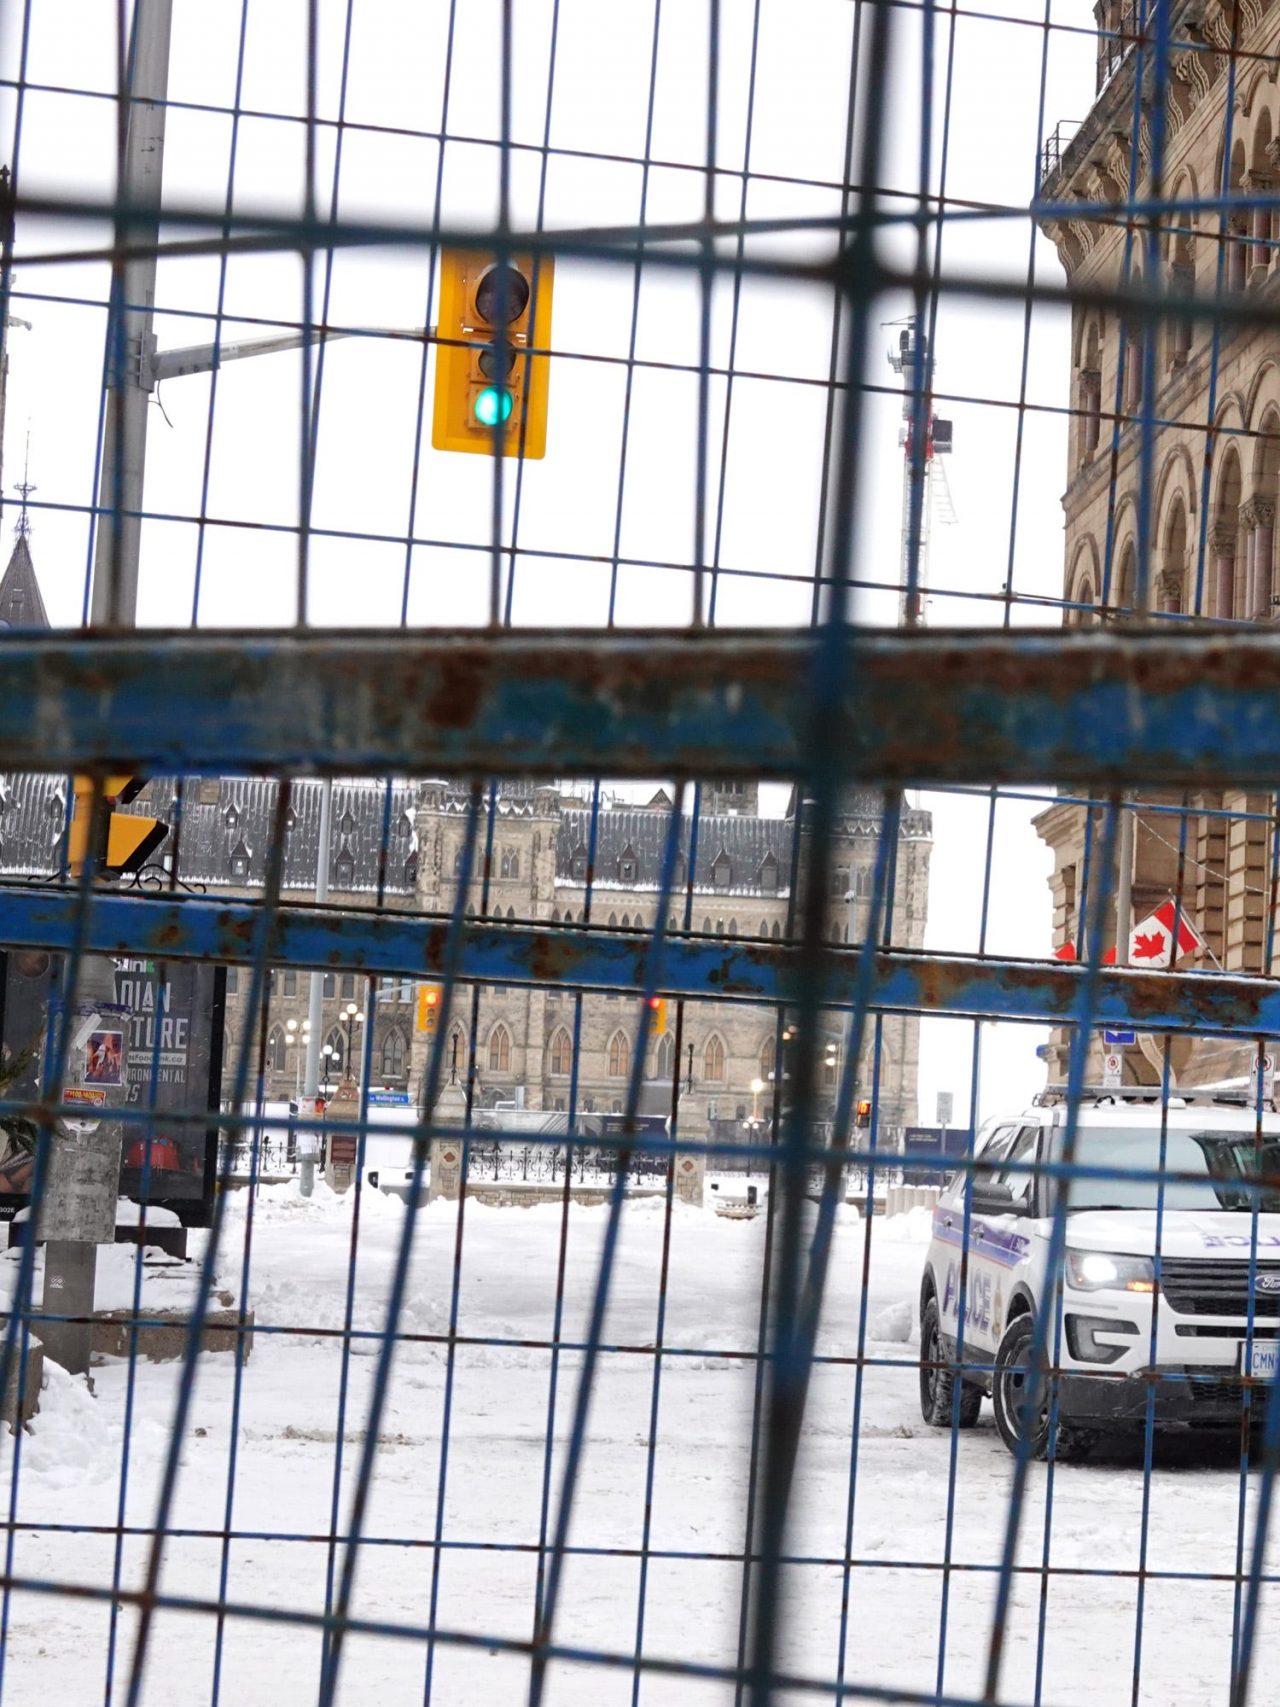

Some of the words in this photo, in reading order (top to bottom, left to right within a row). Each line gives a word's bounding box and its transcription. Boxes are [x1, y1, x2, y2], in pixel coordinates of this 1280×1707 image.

[113, 980, 171, 1012] DIAN
[130, 1016, 188, 1049] TURE
[1251, 1352, 1275, 1370] CMN
